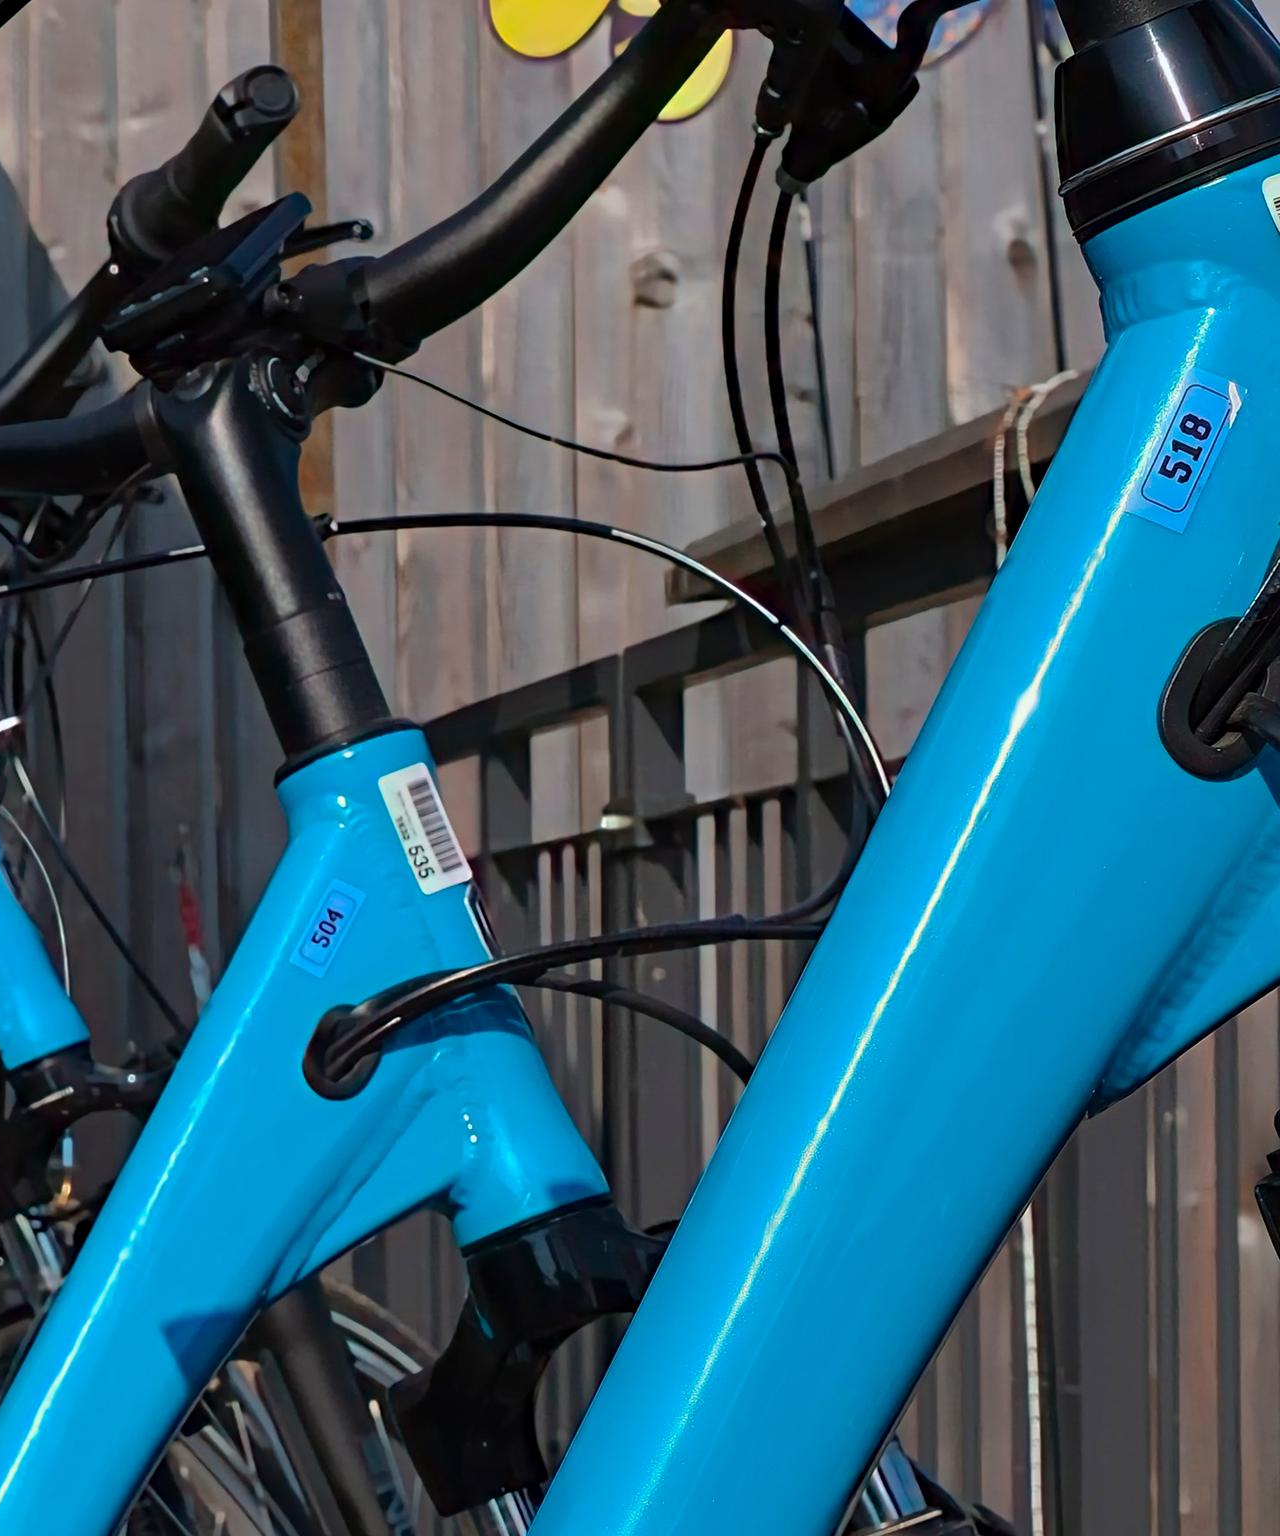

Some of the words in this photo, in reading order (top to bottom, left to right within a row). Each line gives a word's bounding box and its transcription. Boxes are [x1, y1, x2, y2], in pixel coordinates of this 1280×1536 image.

[1158, 413, 1213, 484] 518
[408, 845, 436, 880] 535
[311, 908, 345, 949] 504
